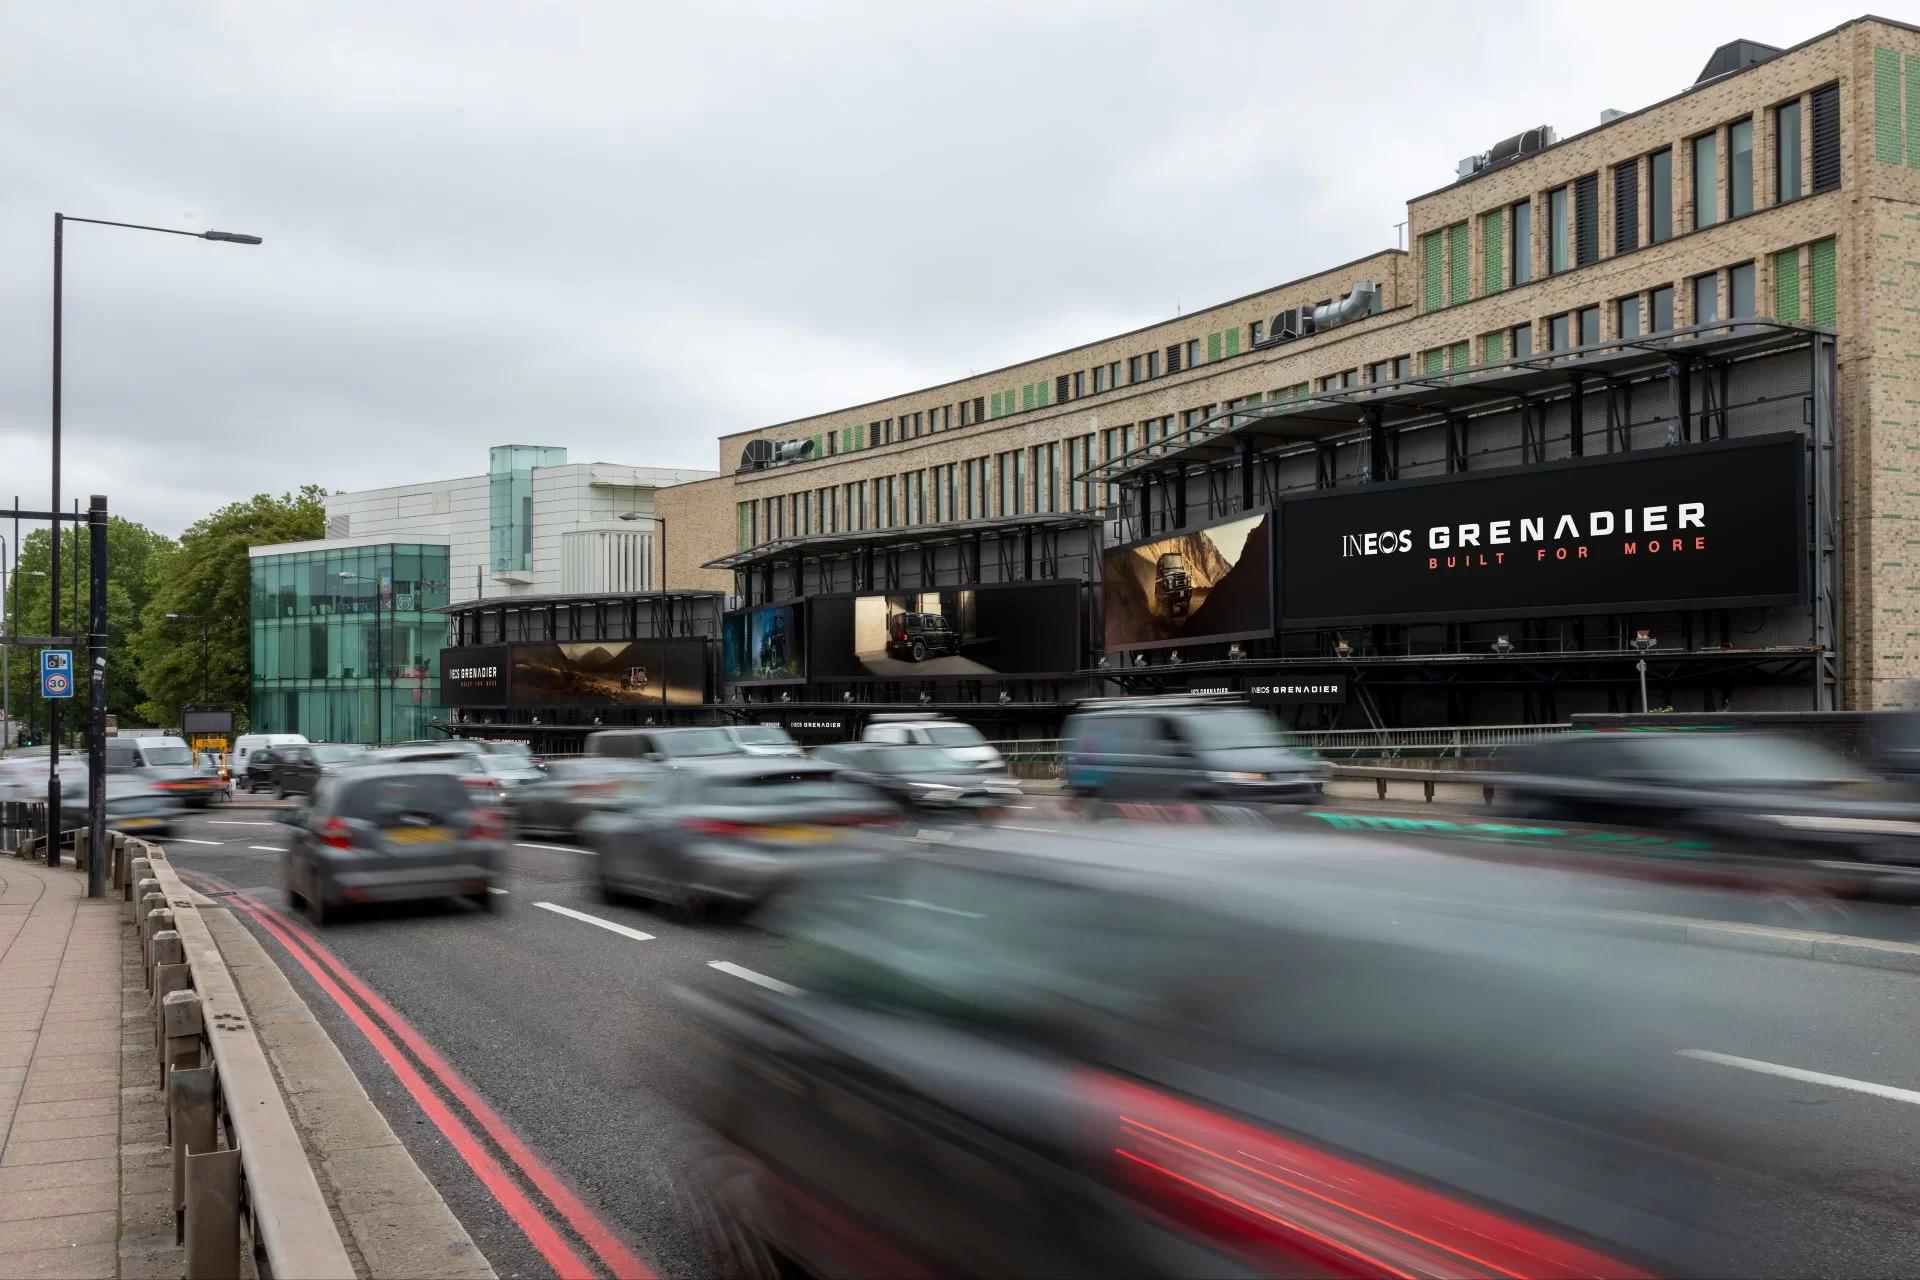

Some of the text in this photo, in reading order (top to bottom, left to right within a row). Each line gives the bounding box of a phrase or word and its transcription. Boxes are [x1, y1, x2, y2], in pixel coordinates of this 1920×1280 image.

[1342, 502, 1706, 557] INEOS GRENADIER
[1428, 537, 1705, 569] BUILT FOR MORE
[461, 666, 497, 679] GRENADIER
[49, 679, 66, 688] 30
[1251, 685, 1338, 694] INEOS GRENADIER
